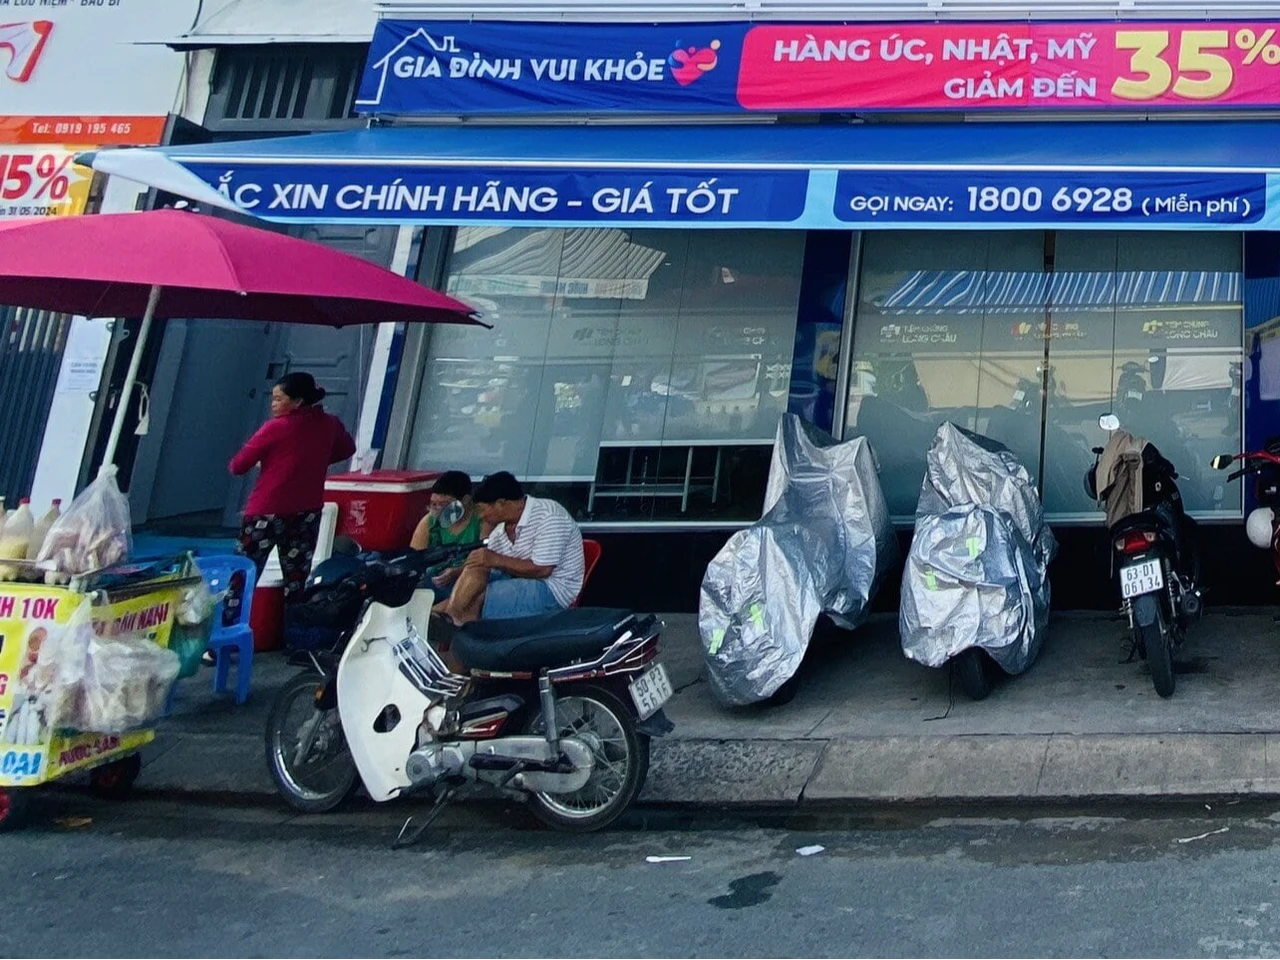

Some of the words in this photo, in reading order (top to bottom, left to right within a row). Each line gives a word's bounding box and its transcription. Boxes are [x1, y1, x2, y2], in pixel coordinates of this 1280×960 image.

[773, 34, 871, 62] HÀNG
[879, 32, 934, 64] ÚC,
[942, 35, 1039, 68] NHẬT,
[1047, 31, 1097, 61] MỸ
[394, 55, 442, 79] GIA
[449, 51, 521, 81] ĐÌNH
[531, 59, 577, 82] VUI
[584, 52, 665, 82] KHỎE
[944, 71, 1024, 100] GIẢM
[1031, 70, 1097, 99] ĐẾN
[32, 123, 50, 134] Tel:
[87, 123, 106, 134] 195
[110, 123, 131, 134] 465
[210, 170, 262, 209] ẮC
[268, 183, 329, 209] XIN
[335, 178, 446, 212] CHÍNH
[453, 181, 558, 213] HÃNG
[592, 181, 654, 214] GIÁ
[666, 178, 739, 214] TỐT
[850, 195, 890, 215] GỌI
[893, 196, 953, 213] NGAY:
[967, 186, 1043, 213] 1800
[1051, 186, 1133, 213] 6928
[22, 597, 60, 620] 10K
